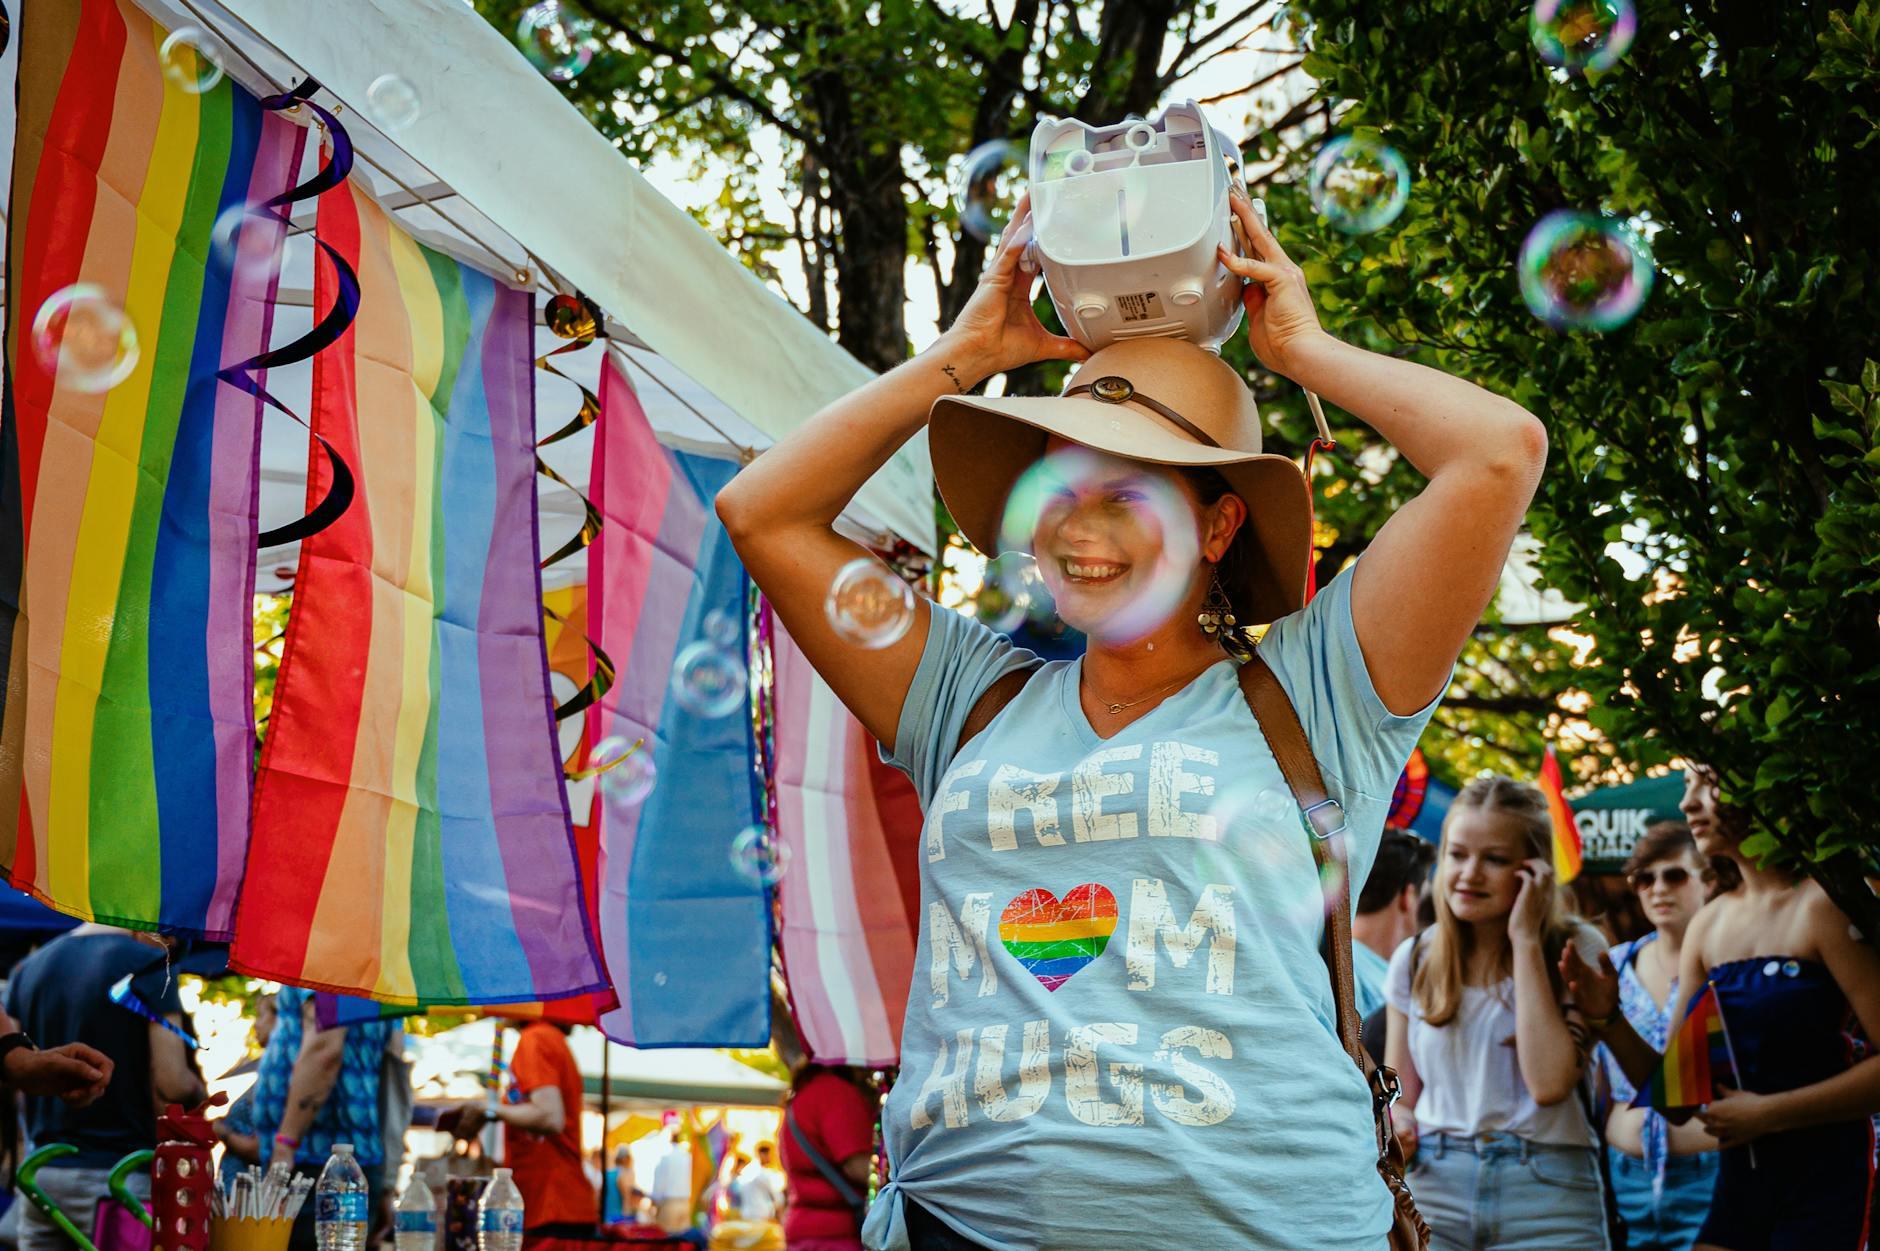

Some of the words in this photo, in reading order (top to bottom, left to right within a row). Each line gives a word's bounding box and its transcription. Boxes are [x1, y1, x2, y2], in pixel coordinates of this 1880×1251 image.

[927, 740, 1219, 863] FREE
[1574, 808, 1655, 838] QUIK
[910, 1019, 1236, 1130] HUGS
